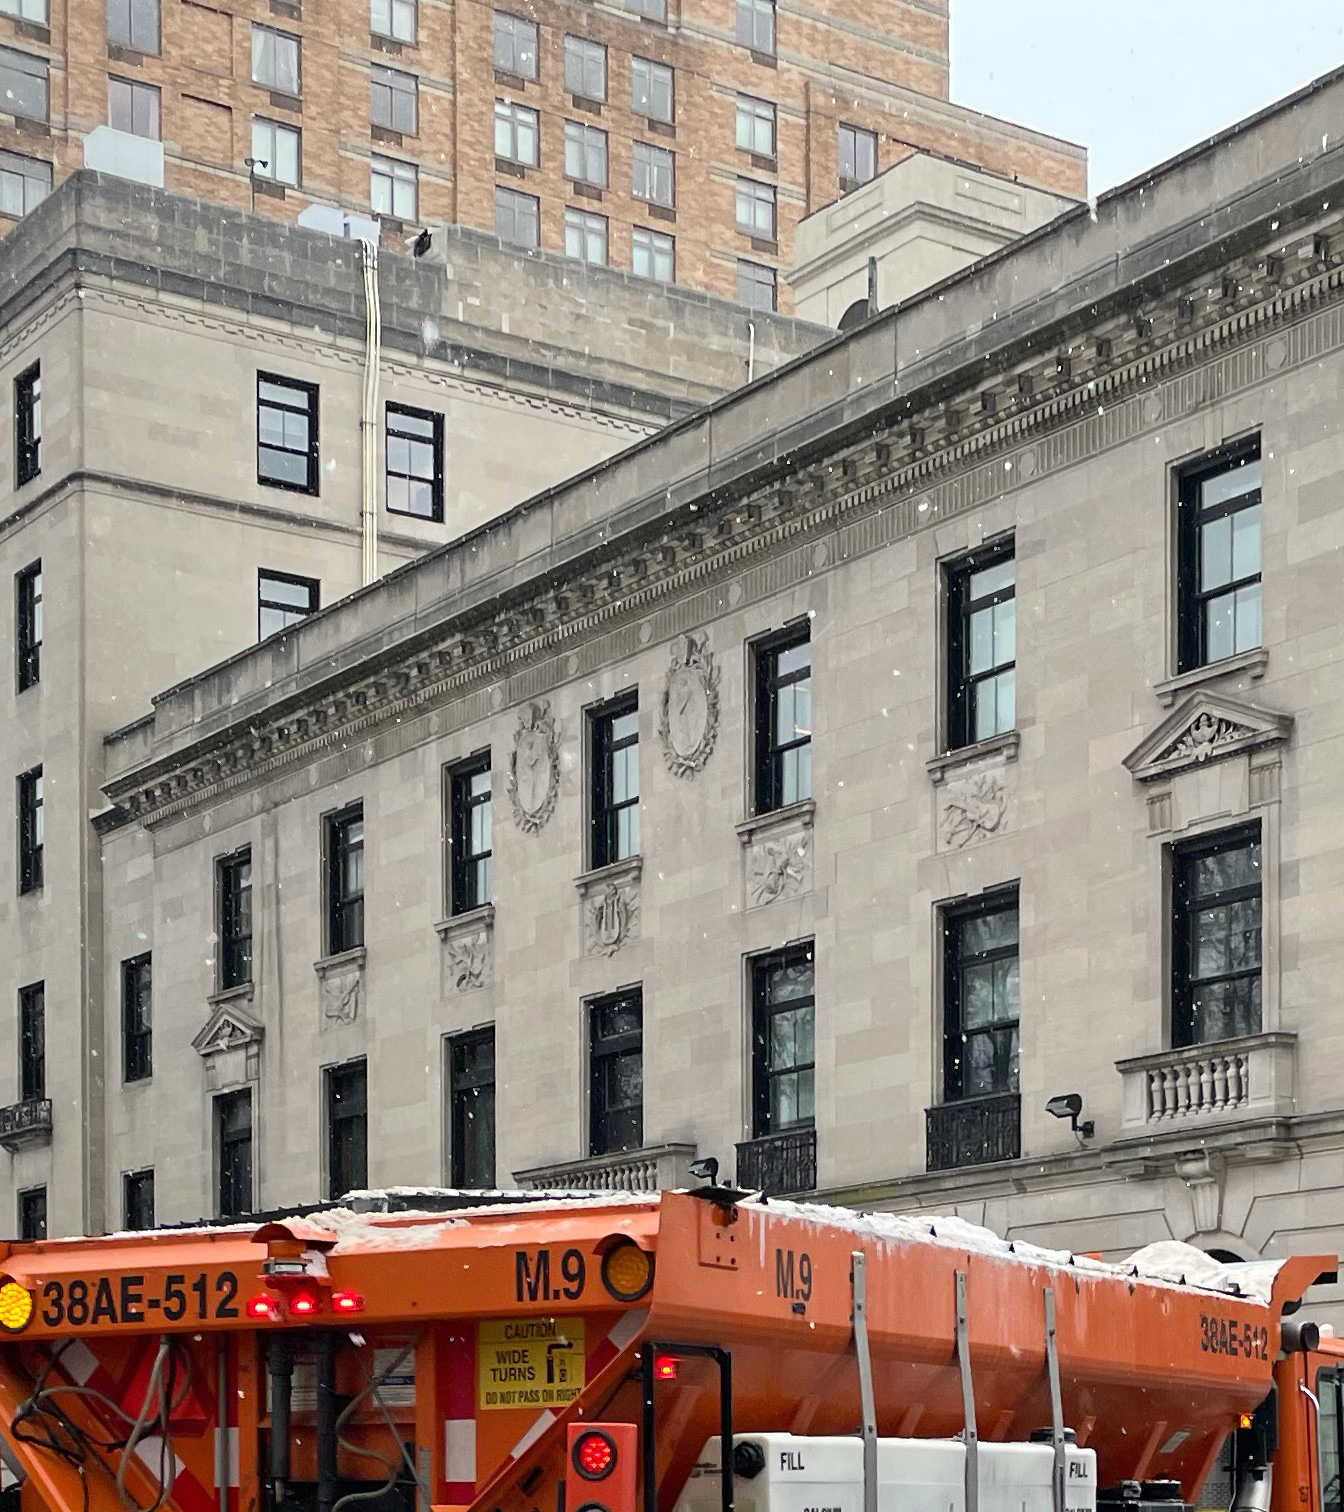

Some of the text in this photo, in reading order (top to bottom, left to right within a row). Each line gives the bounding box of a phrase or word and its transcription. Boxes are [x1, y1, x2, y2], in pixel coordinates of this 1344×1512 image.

[515, 1249, 586, 1302] M.9
[776, 1248, 812, 1301] M.9
[42, 1271, 239, 1327] 38AE-512
[505, 1321, 557, 1340] CAUTION
[1199, 1312, 1268, 1361] 38AE-512
[495, 1349, 530, 1365] WIDE
[491, 1366, 536, 1384] TURNS
[485, 1387, 582, 1405] DO NOT PASS ON RIGHT
[780, 1452, 805, 1471] FILL
[1069, 1461, 1088, 1478] FILL
